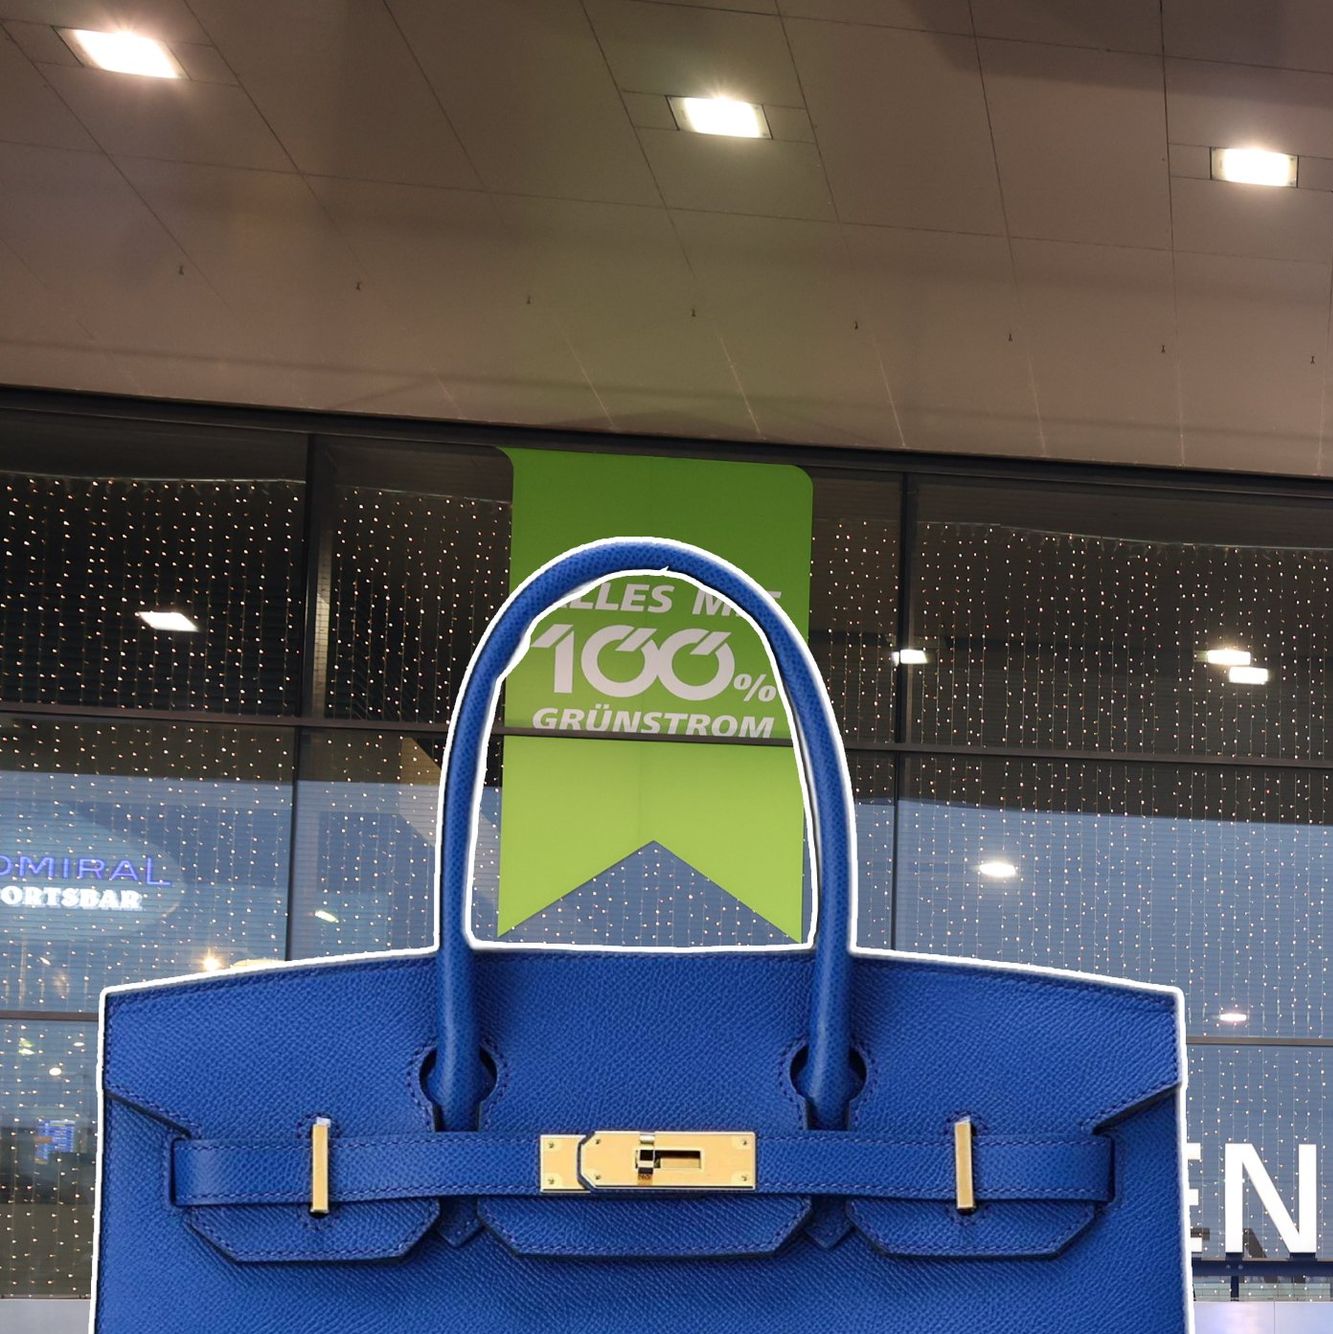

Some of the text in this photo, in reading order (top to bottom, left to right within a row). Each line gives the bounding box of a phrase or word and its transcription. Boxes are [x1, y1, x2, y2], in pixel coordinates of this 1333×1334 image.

[558, 583, 675, 613] LLES
[531, 624, 776, 702] 100%
[532, 703, 774, 738] GRÜNSTROM
